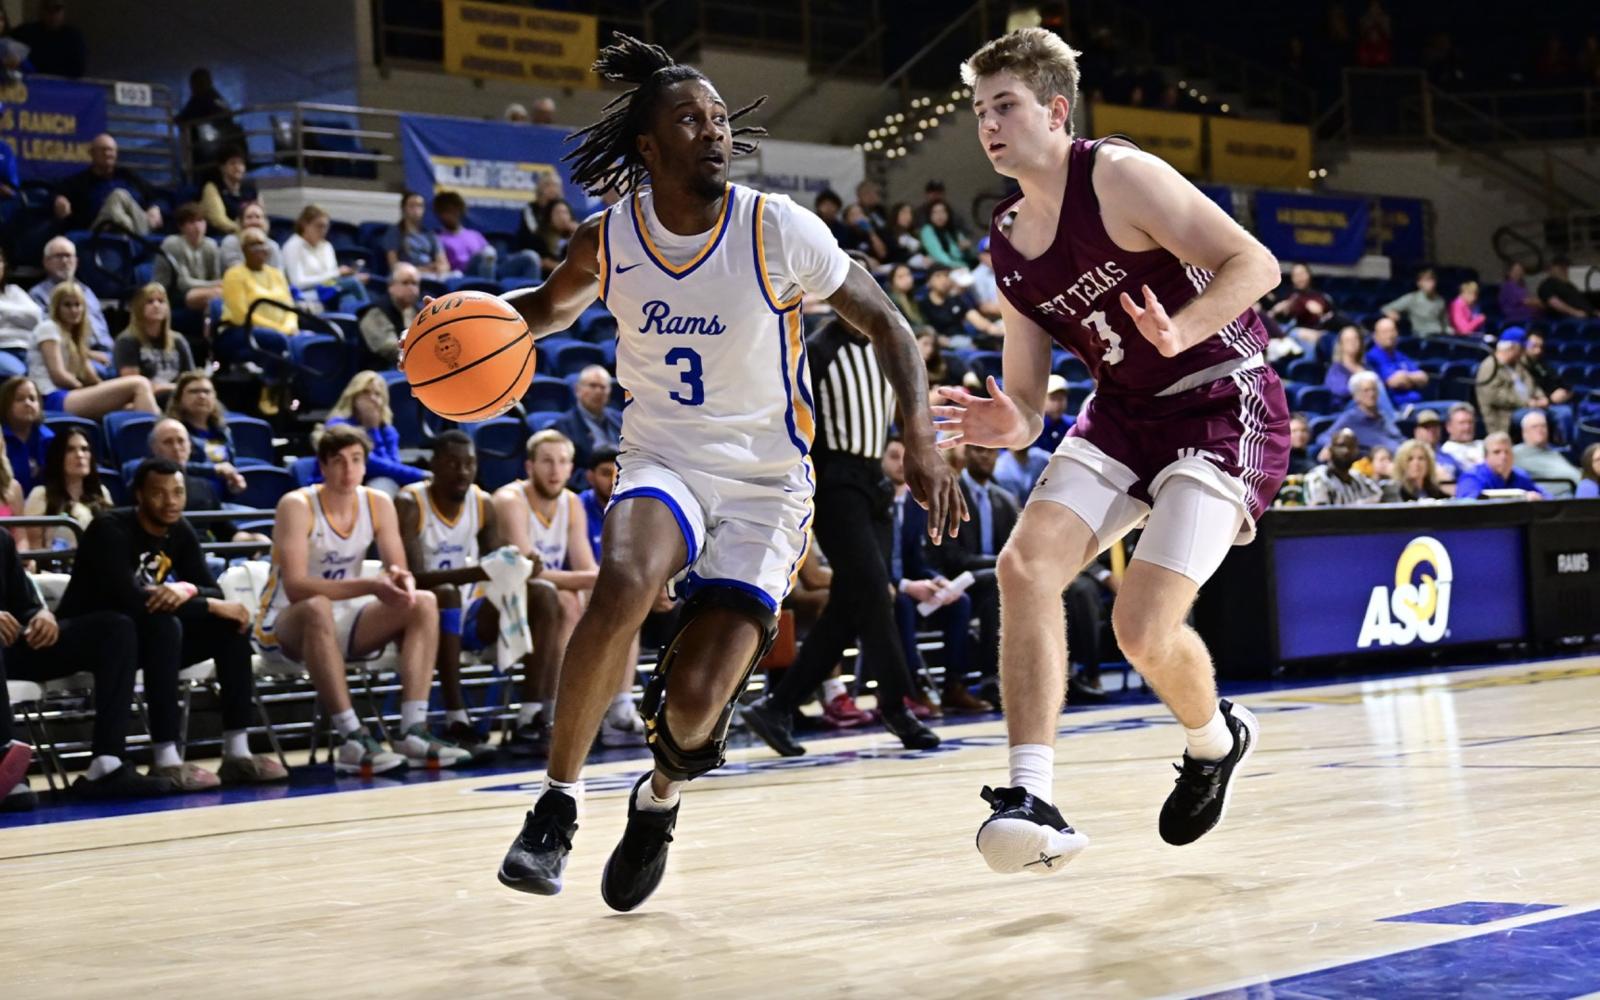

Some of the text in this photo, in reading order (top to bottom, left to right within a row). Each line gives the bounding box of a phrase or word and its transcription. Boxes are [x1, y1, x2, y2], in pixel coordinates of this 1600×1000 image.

[120, 85, 147, 101] 103
[18, 110, 77, 134] RANCH
[22, 138, 94, 163] LEGRAN
[1066, 261, 1128, 307] TEXAS
[416, 297, 464, 326] EVO
[638, 300, 727, 336] Rams
[1080, 310, 1125, 366] 3
[664, 347, 705, 406] 3
[1557, 553, 1589, 573] RAMS
[1356, 578, 1453, 648] ASU
